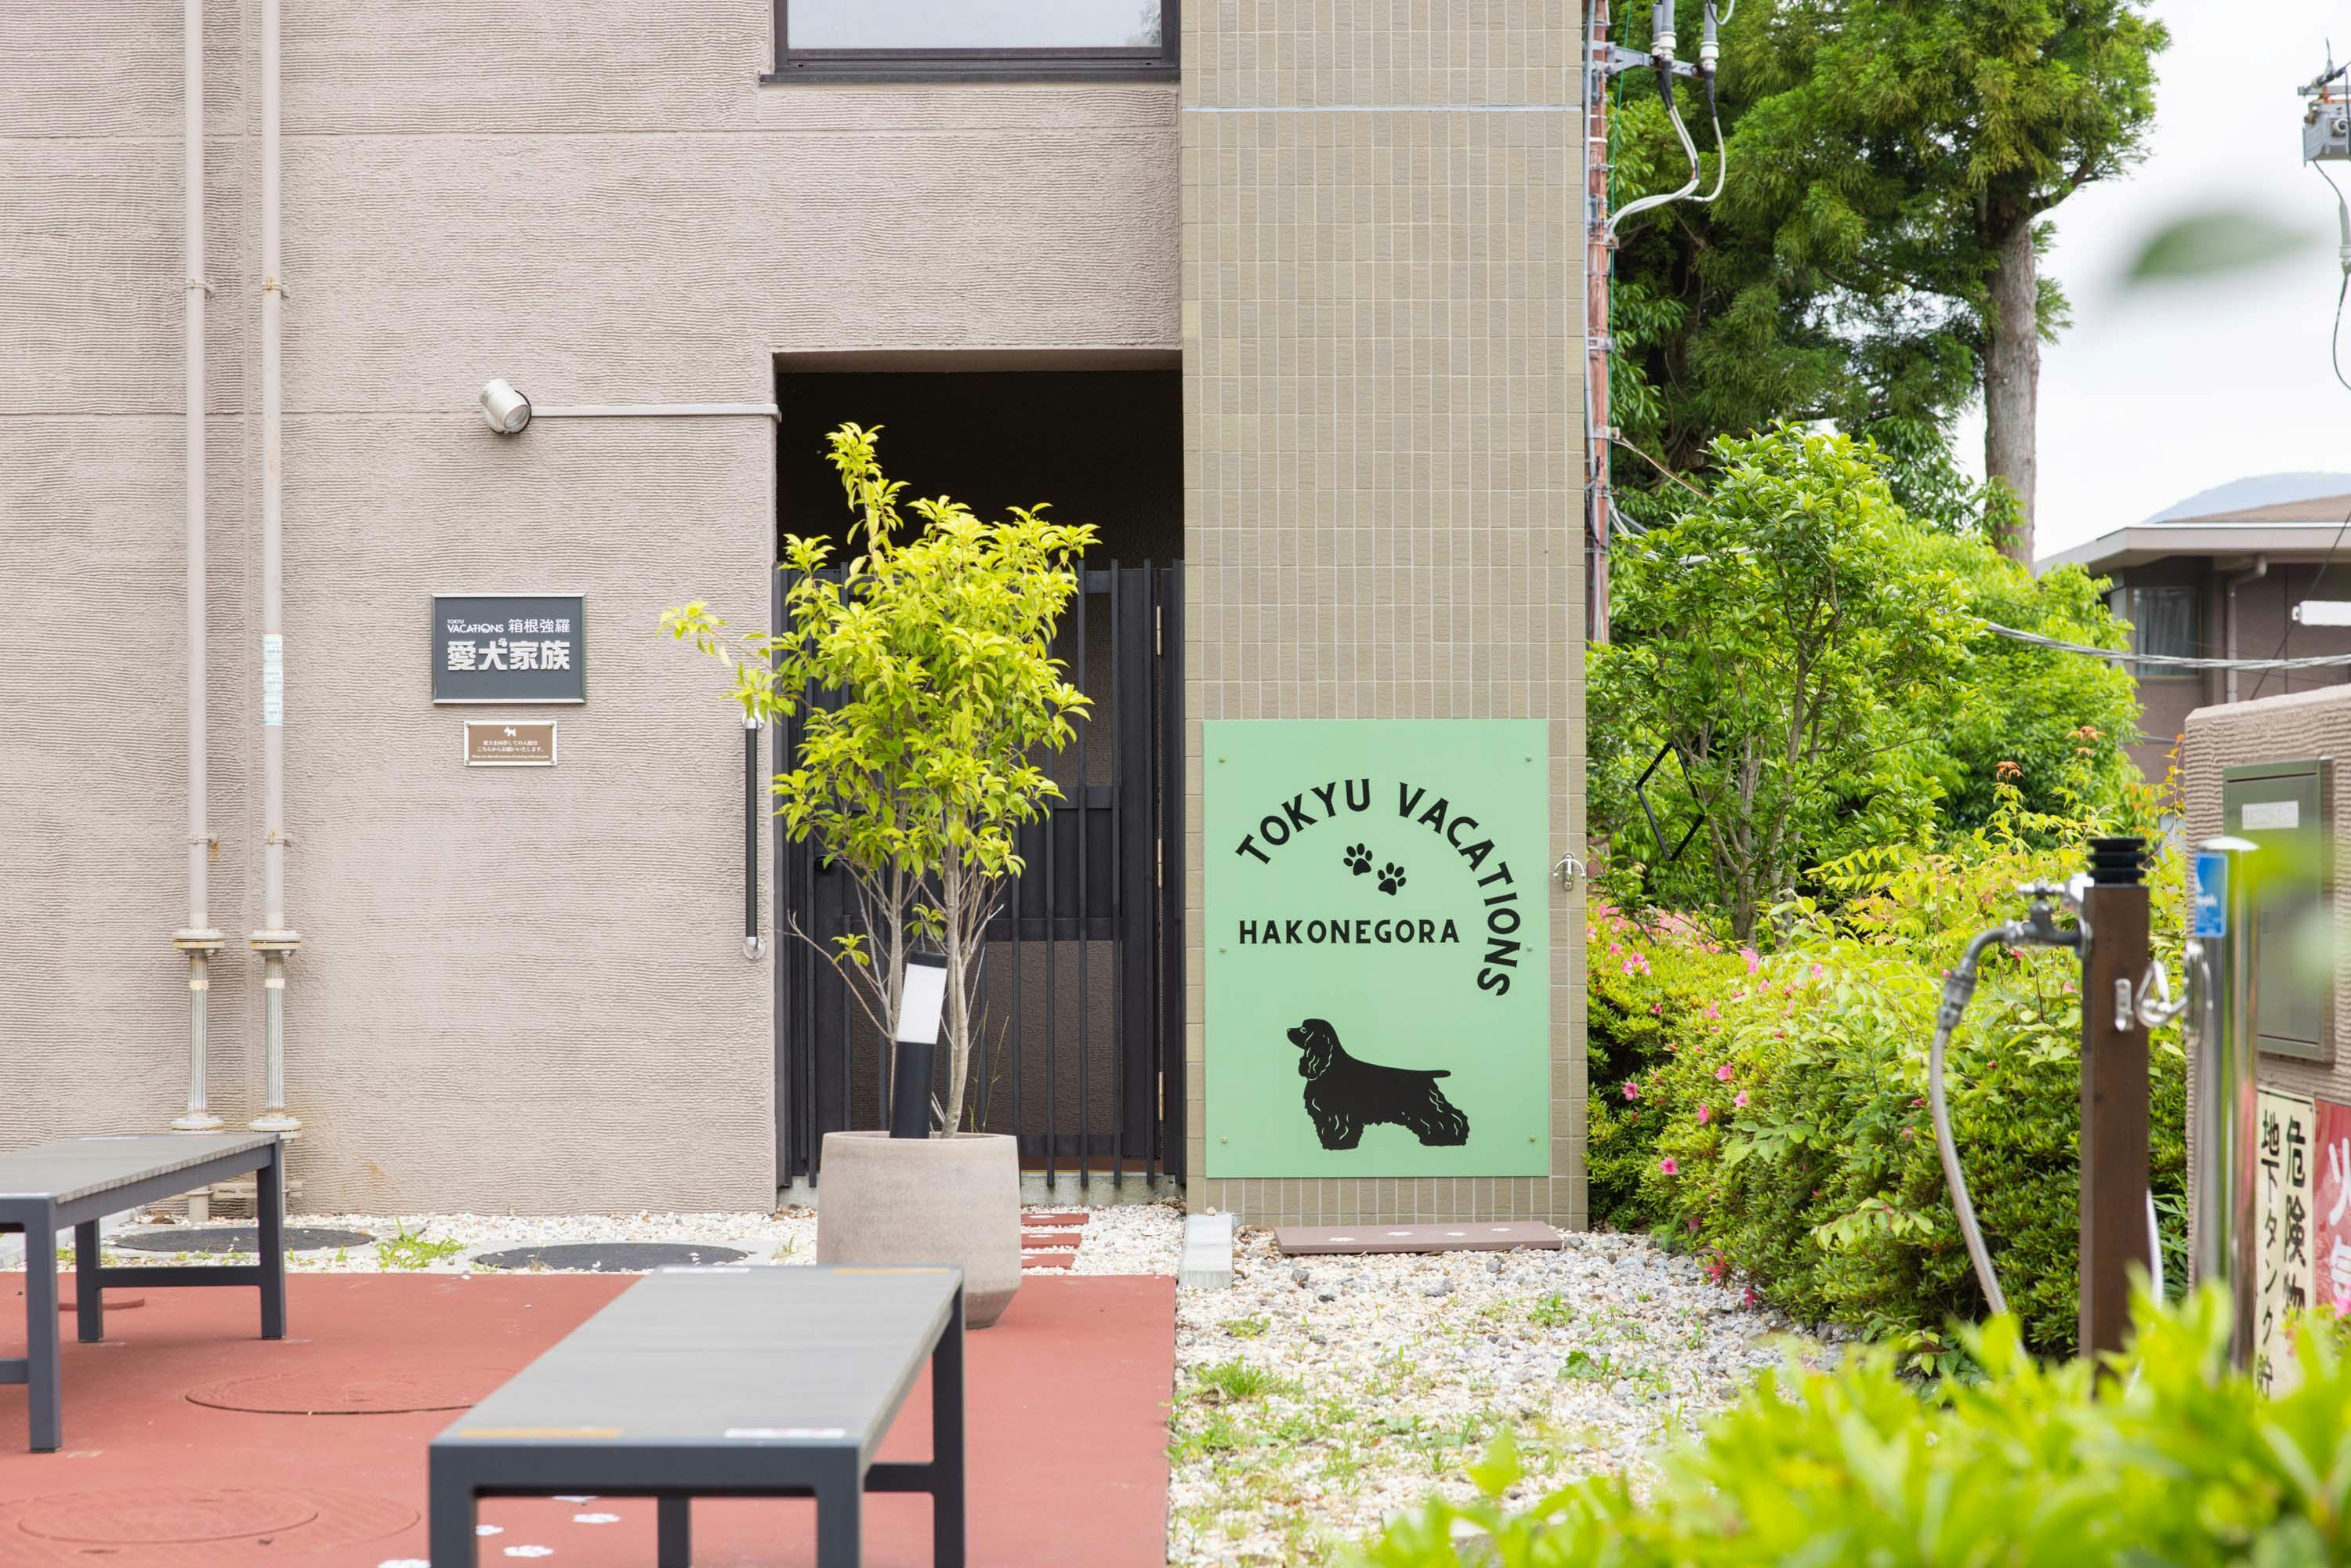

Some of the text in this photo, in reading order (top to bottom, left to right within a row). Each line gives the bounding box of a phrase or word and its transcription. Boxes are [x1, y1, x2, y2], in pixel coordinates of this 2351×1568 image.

[447, 624, 504, 634] VACATIONS
[508, 618, 571, 634] 箱根強羅
[447, 640, 571, 671] 愛犬家族
[1234, 778, 1521, 996] TOKYU VACATIONS
[1239, 919, 1461, 944] HAKONEGORA
